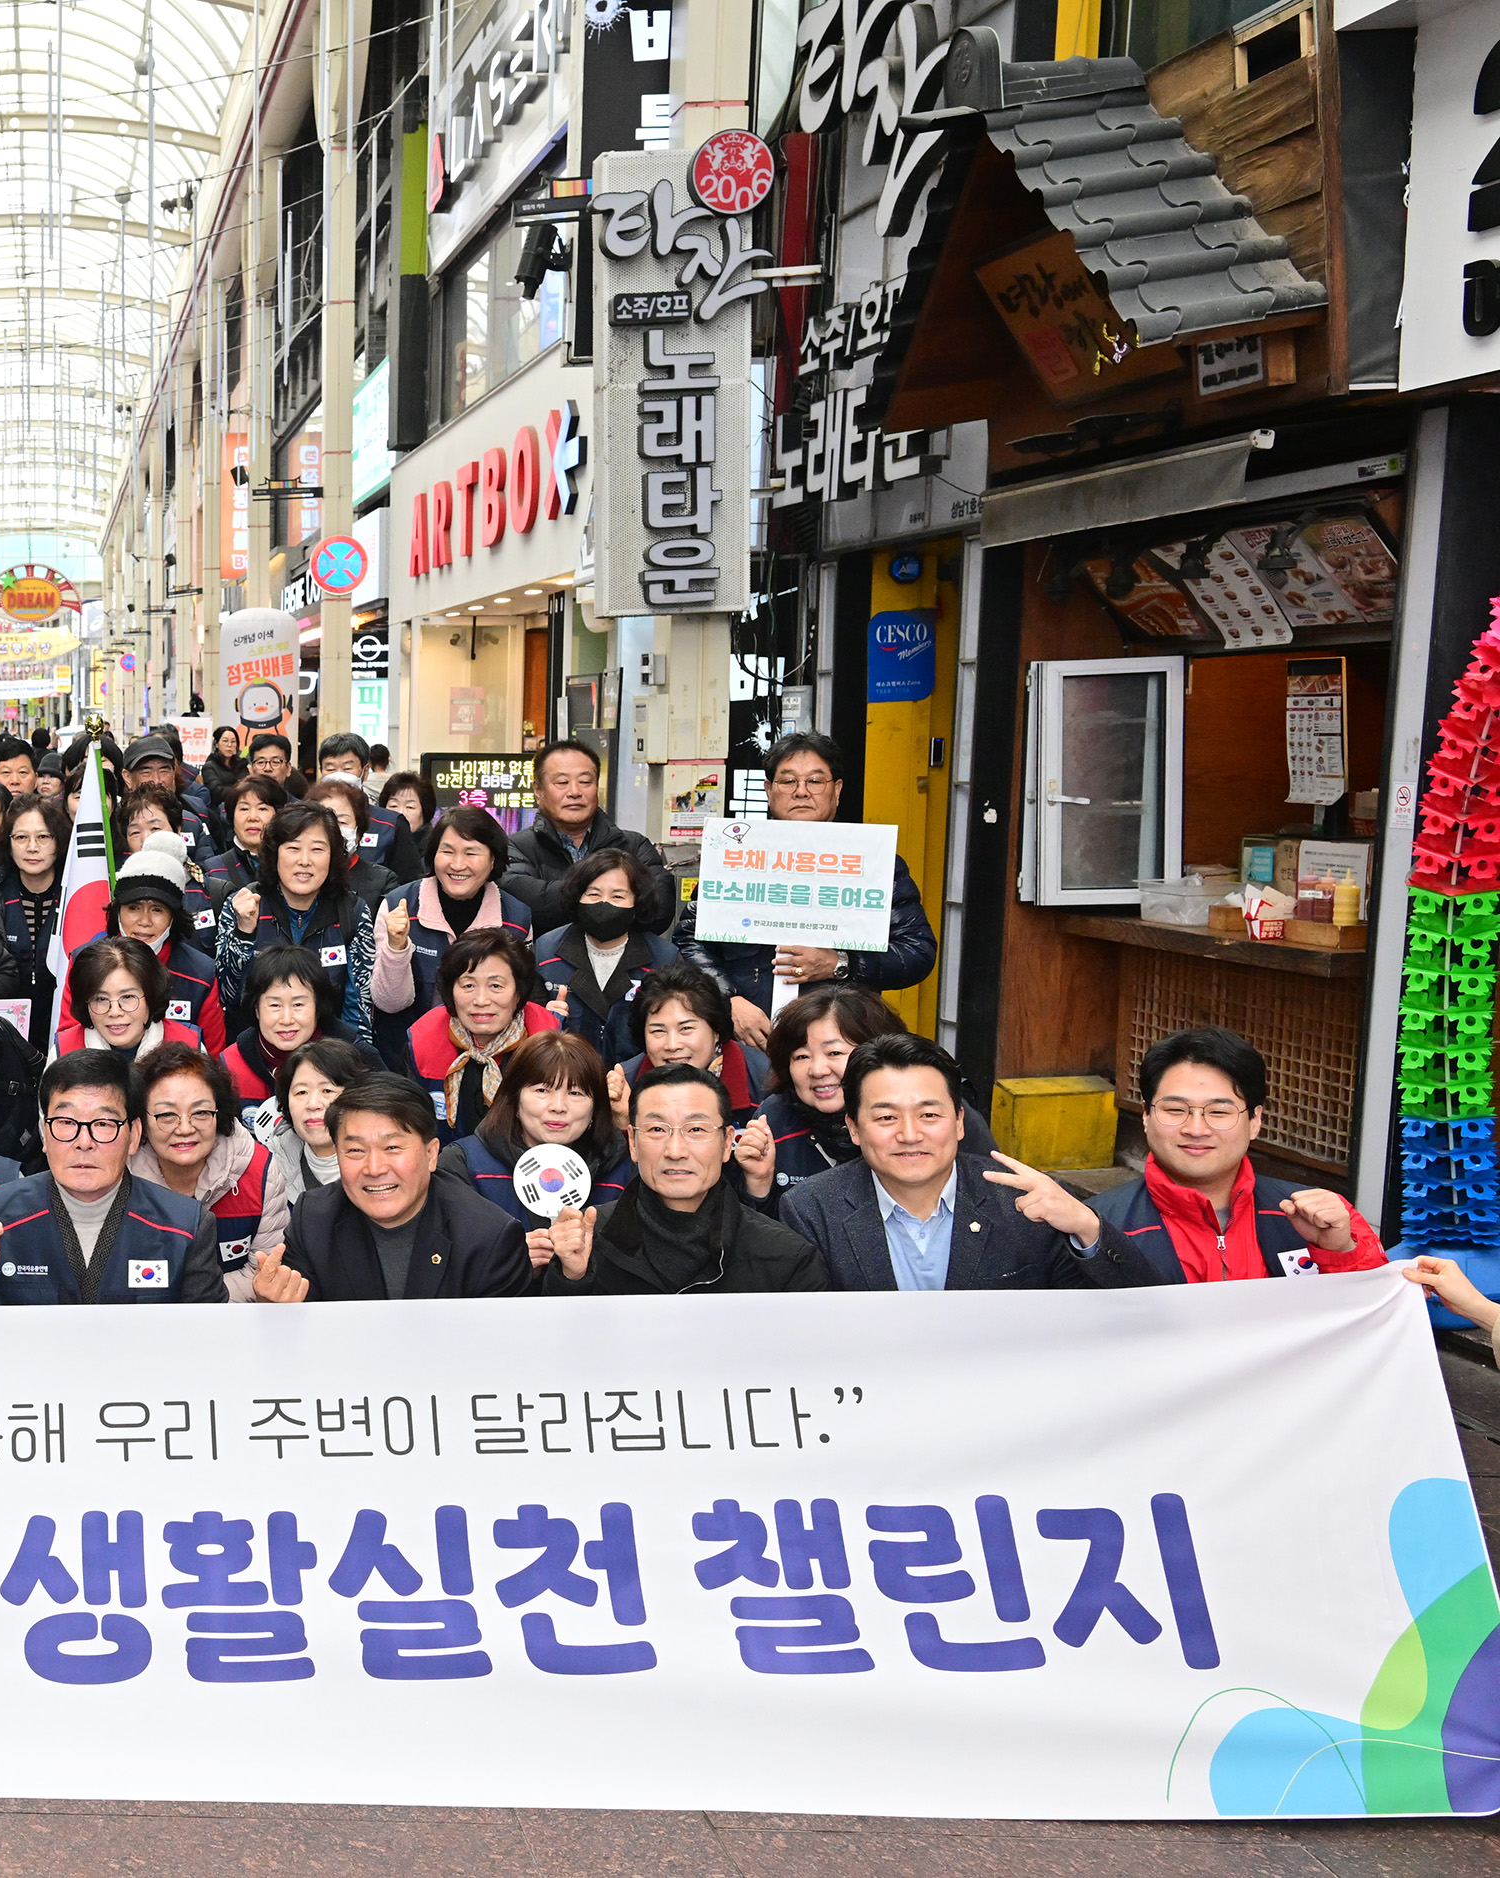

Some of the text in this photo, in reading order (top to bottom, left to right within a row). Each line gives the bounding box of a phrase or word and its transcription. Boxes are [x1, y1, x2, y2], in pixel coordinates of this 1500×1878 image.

[700, 168, 772, 211] 2006
[616, 293, 690, 320] 소주/호프
[639, 328, 722, 606] 노래타운
[409, 400, 586, 578] ARTBOX
[6, 591, 55, 609] DREAM
[233, 629, 275, 647] 신개념 이색
[875, 623, 928, 643] CESCO
[226, 653, 295, 686] 점핑배틀
[436, 773, 479, 789] 안전한
[450, 760, 506, 775] 나이제한
[458, 789, 489, 808] 3층
[722, 849, 863, 876] 부채 사용으로
[702, 879, 886, 910] 탄소배출을 줄여요
[95, 1399, 218, 1463] 우리
[248, 1394, 441, 1460] 주변이
[471, 1386, 863, 1455] 달라집니다.”
[0, 1502, 658, 1685] 생활실천
[692, 1492, 1220, 1675] 챌린지
